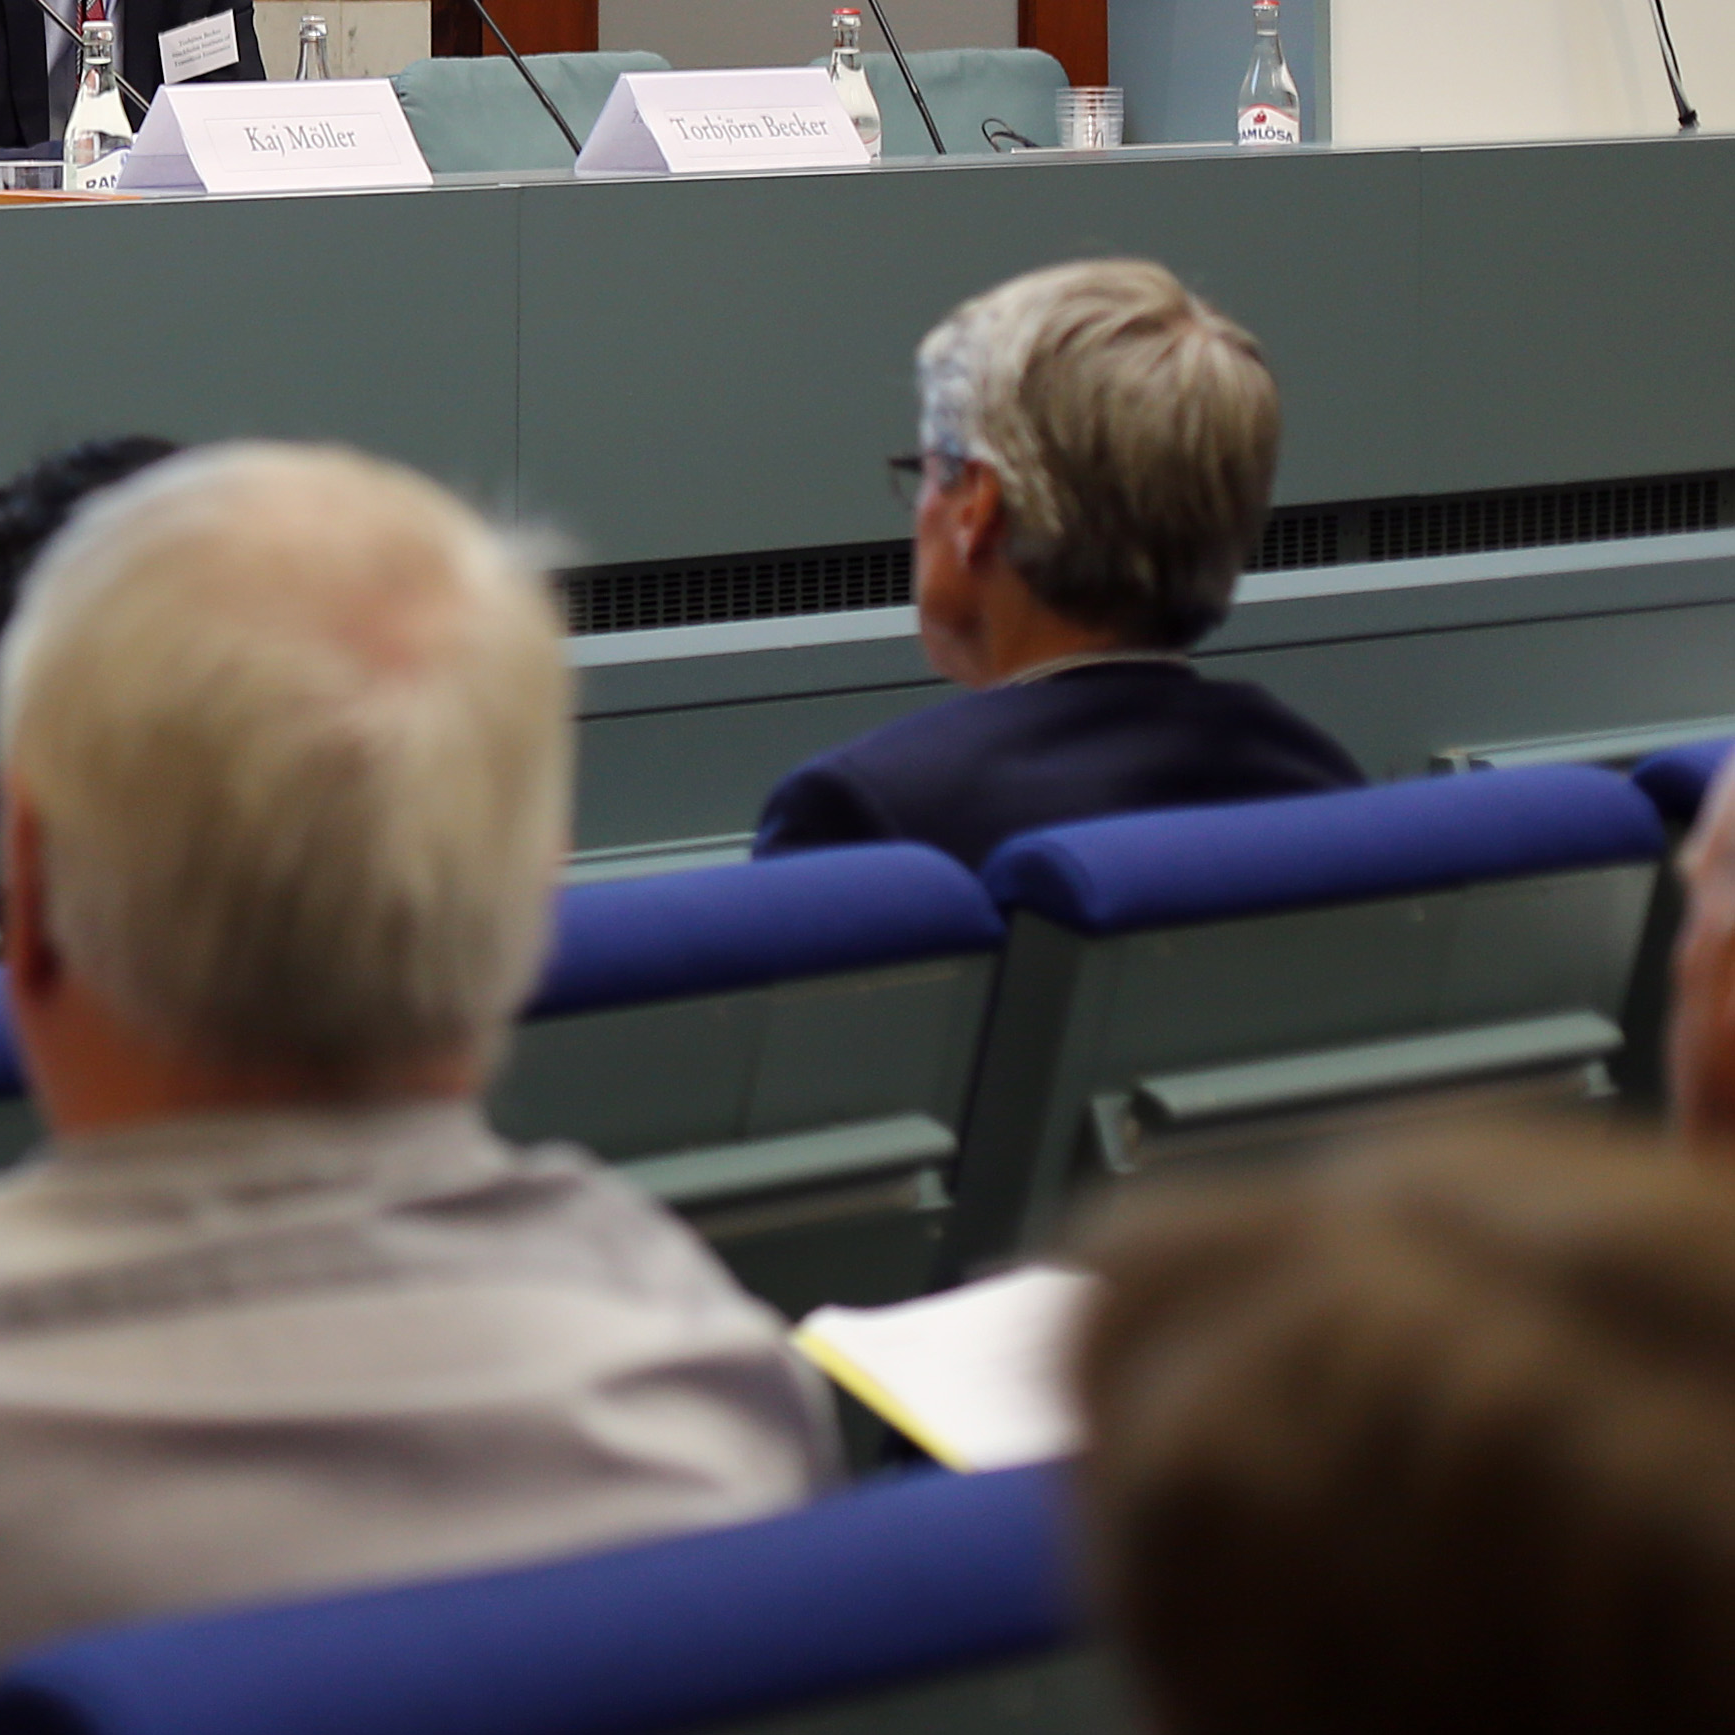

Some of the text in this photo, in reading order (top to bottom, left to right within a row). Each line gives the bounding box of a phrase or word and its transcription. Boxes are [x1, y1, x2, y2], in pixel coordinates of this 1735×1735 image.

[244, 123, 358, 157] Kaj Möller
[670, 115, 762, 145] Torbjörn
[761, 112, 830, 139] Becker
[1240, 126, 1294, 144] AMLÖSA
